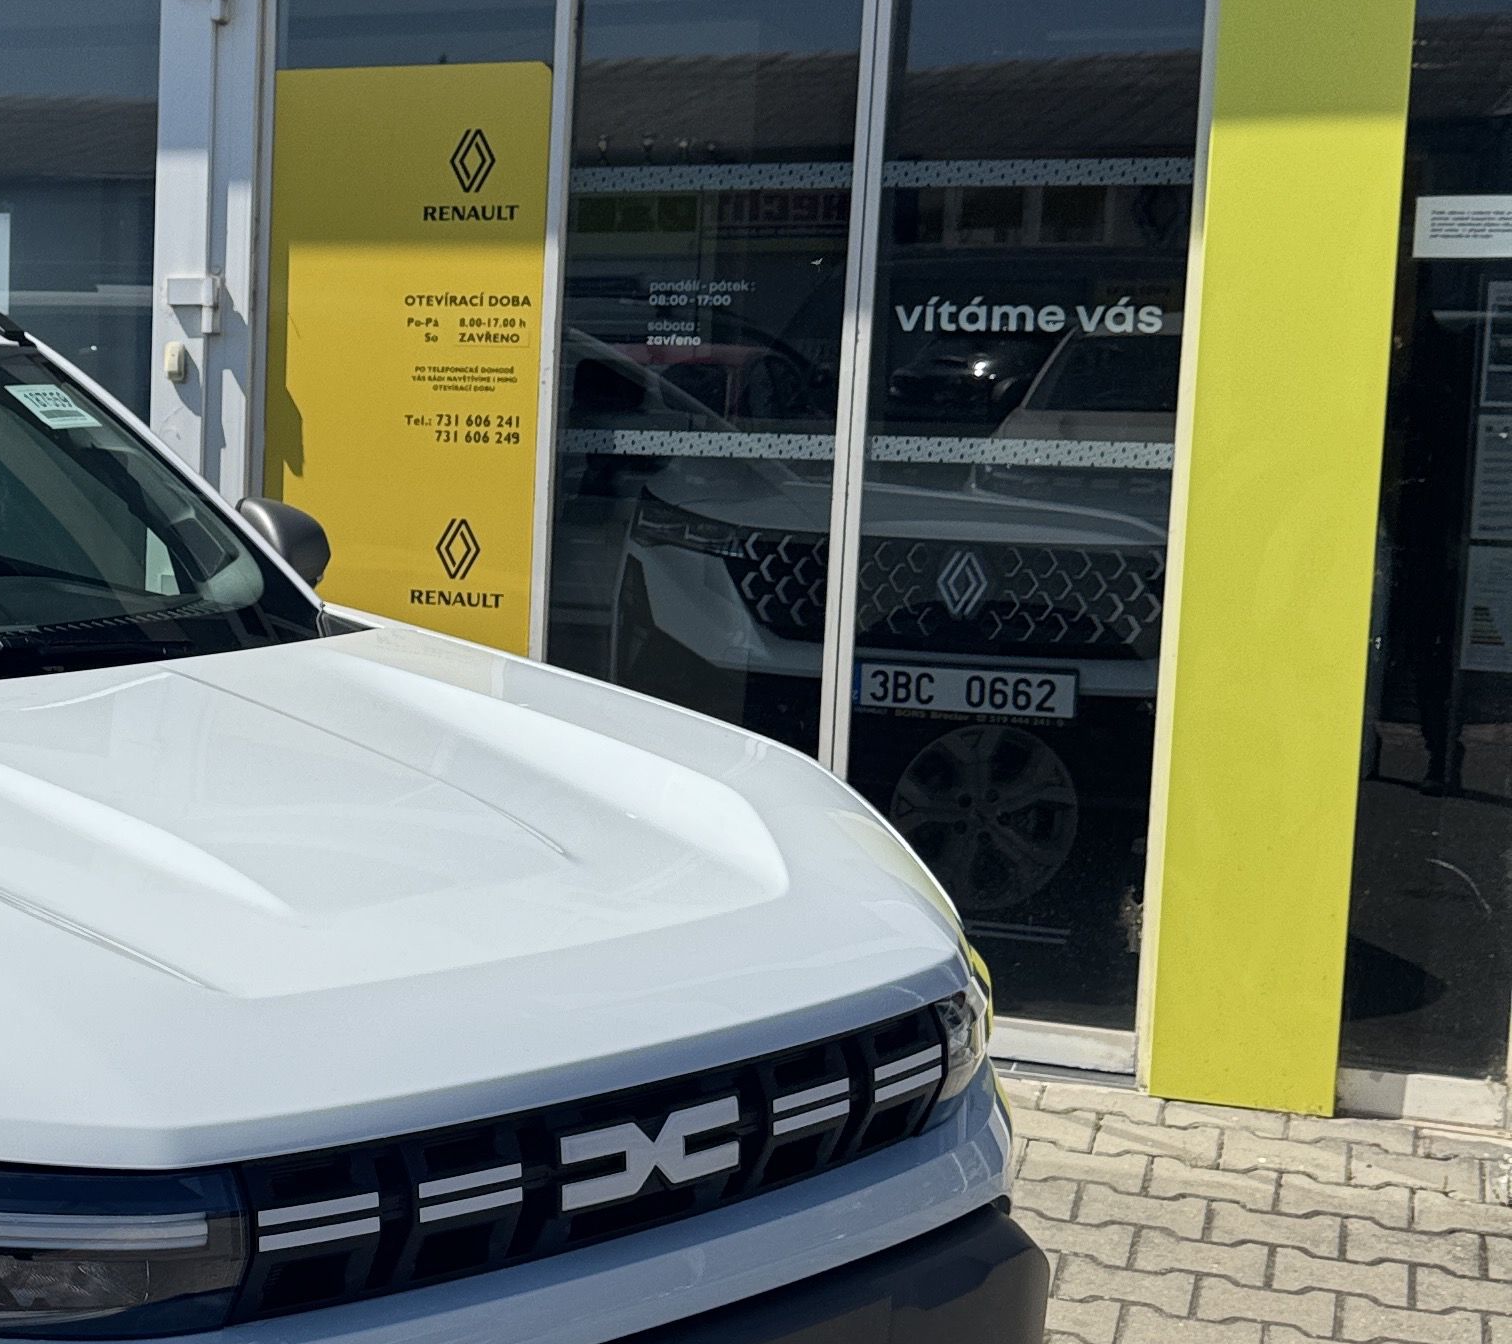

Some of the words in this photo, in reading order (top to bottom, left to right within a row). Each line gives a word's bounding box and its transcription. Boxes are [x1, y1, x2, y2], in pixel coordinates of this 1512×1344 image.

[423, 205, 519, 222] RENAULT
[405, 292, 484, 307] OTEVÍRACÍ
[488, 295, 531, 307] DOBA
[895, 296, 1066, 332] vítáme
[1076, 296, 1163, 334] vás
[424, 333, 438, 343] So
[458, 331, 520, 343] ZAVŘENO
[404, 414, 431, 426] Tel.:
[436, 414, 459, 427] 731
[465, 414, 491, 428] 606
[496, 415, 520, 428] 241
[434, 430, 458, 443] 731
[464, 431, 490, 444] 606
[495, 431, 520, 444] 249
[410, 589, 505, 609] RENAULT
[869, 670, 935, 705] 3BC
[965, 675, 1056, 713] 0662
